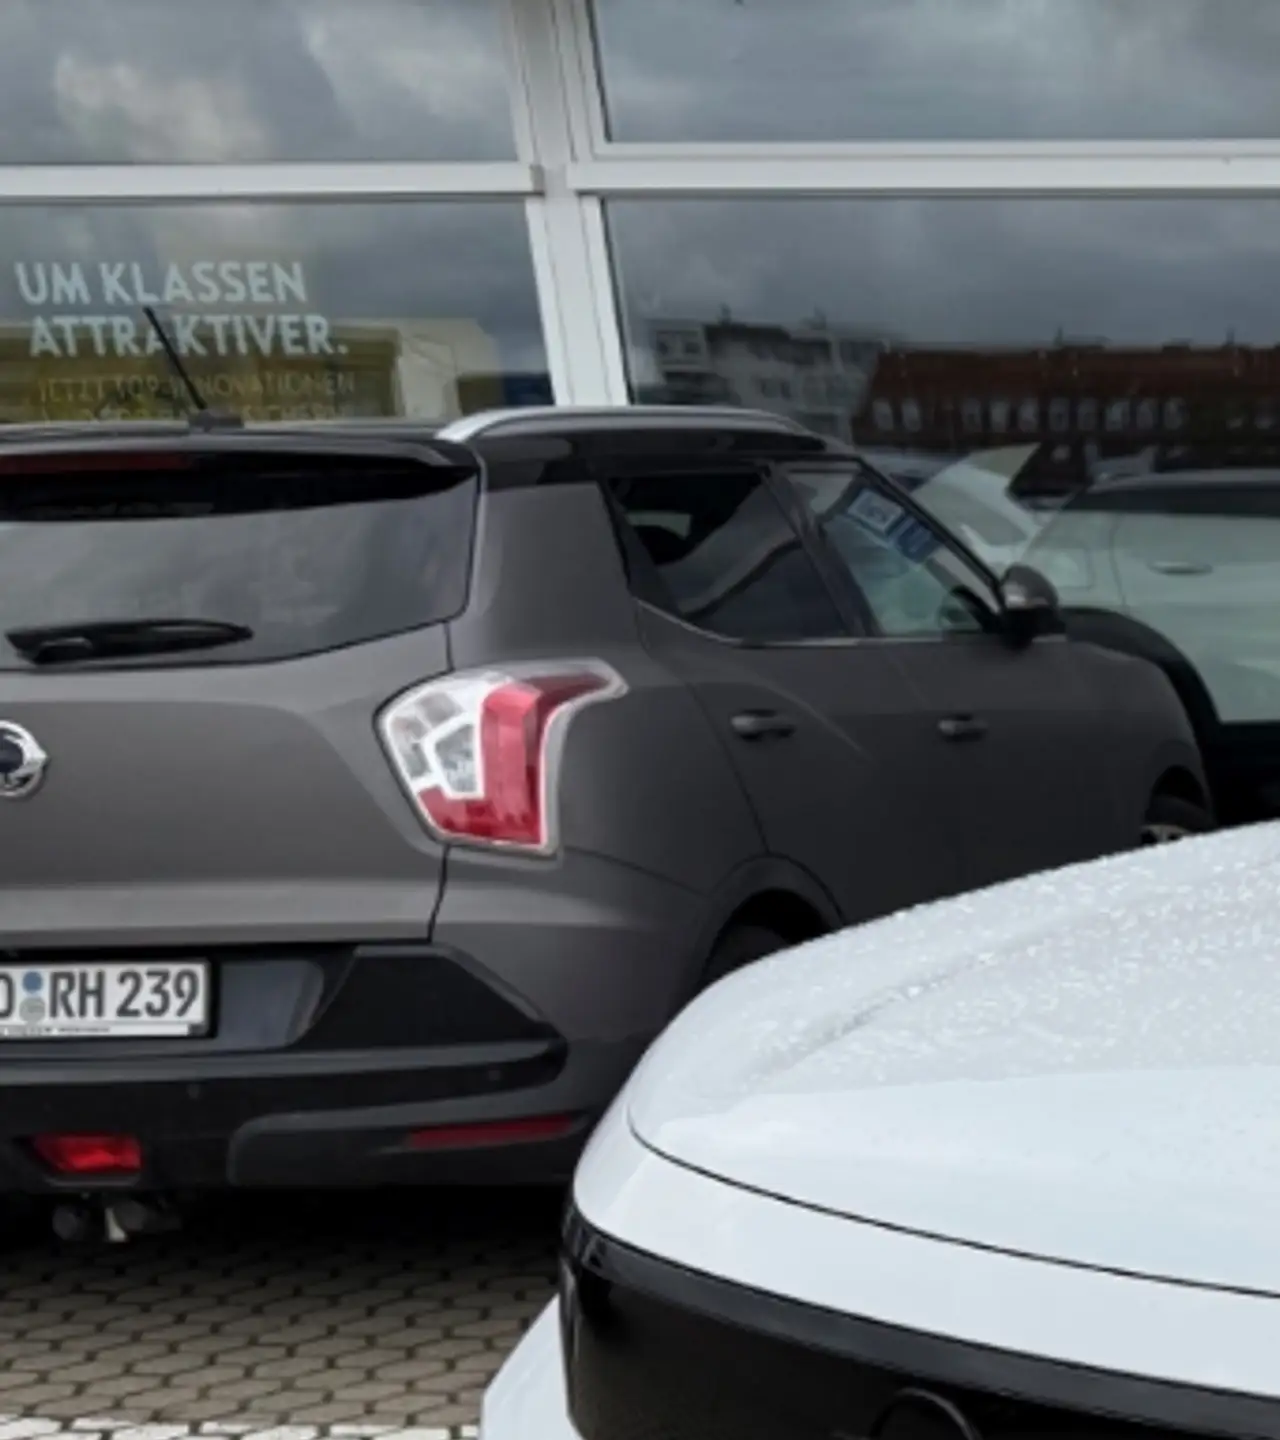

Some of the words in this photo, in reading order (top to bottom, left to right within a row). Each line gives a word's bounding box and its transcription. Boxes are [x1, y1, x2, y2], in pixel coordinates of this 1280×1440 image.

[15, 262, 91, 304] UM
[99, 261, 309, 304] KLASSEN
[29, 314, 349, 358] ATTRAKTIVER.
[49, 969, 104, 1018] RH
[116, 968, 199, 1018] 239
